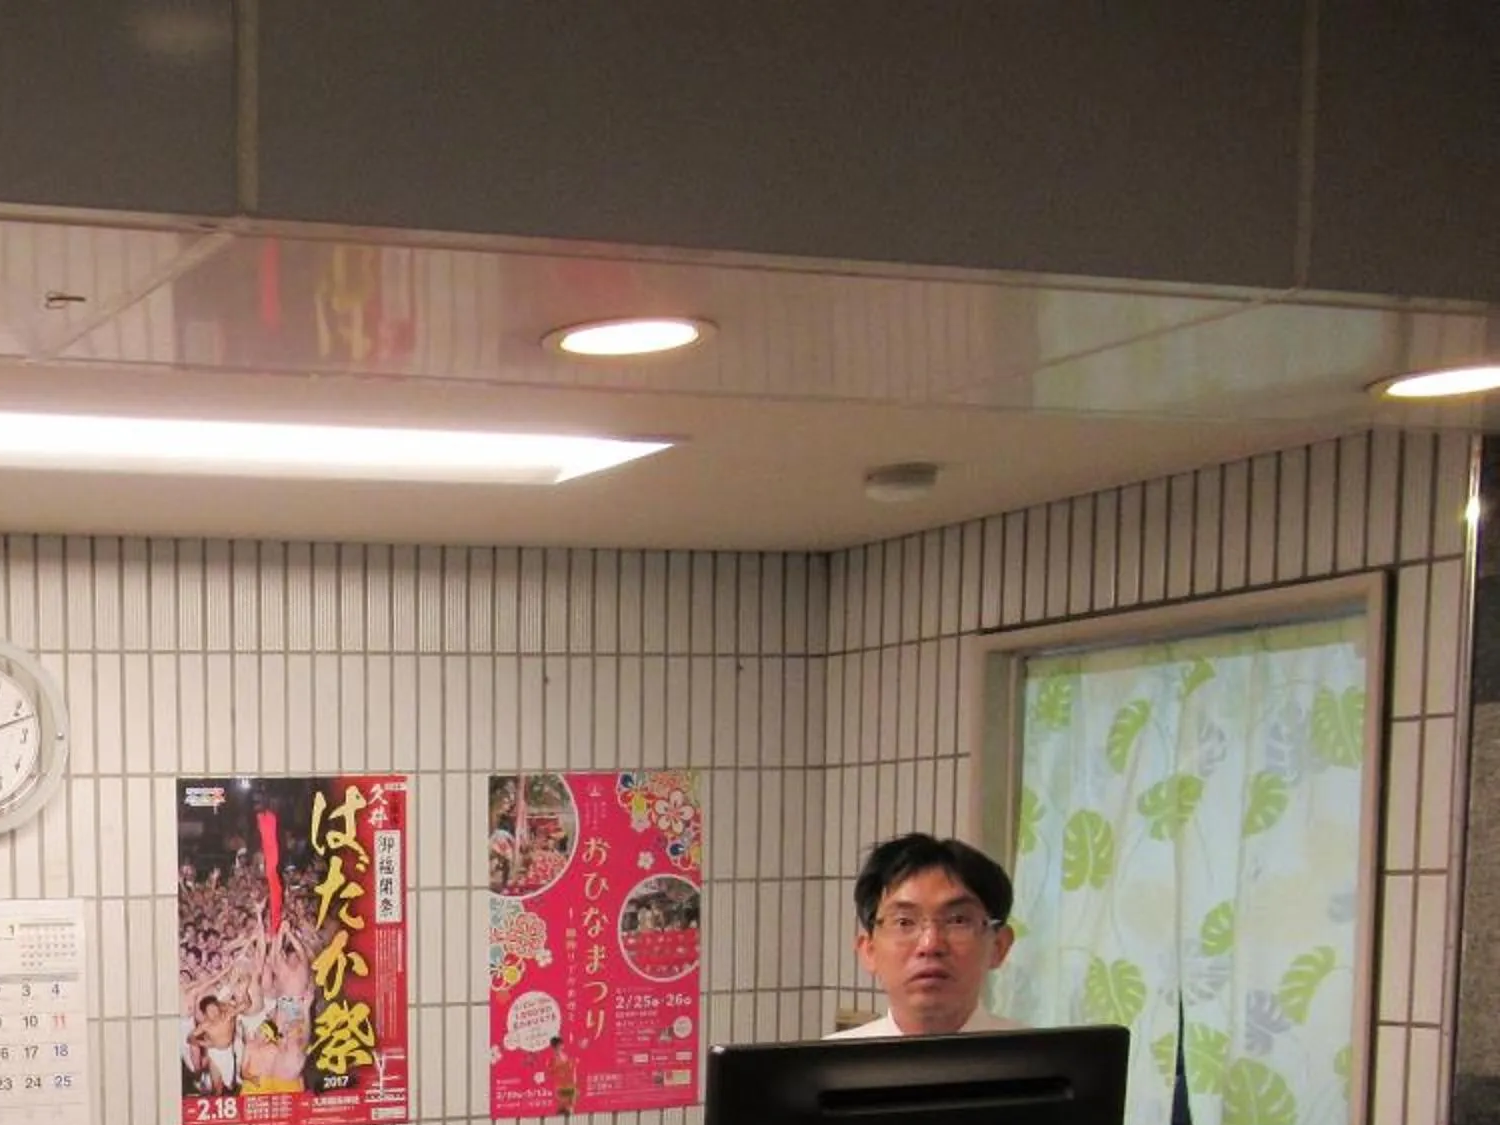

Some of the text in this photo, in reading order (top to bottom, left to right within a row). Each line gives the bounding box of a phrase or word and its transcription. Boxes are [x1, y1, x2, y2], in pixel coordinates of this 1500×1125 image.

[308, 785, 376, 1075] はだか祭
[582, 836, 612, 1042] おひなまつり
[22, 985, 31, 998] 3
[51, 984, 61, 996] 4
[23, 1015, 38, 1029] 10
[52, 1014, 67, 1029] 11
[24, 1046, 39, 1060] 17
[53, 1044, 68, 1058] 18
[25, 1077, 42, 1090] 24
[54, 1075, 72, 1089] 25
[323, 1075, 350, 1089] 2017
[196, 1098, 238, 1122] 2.18
